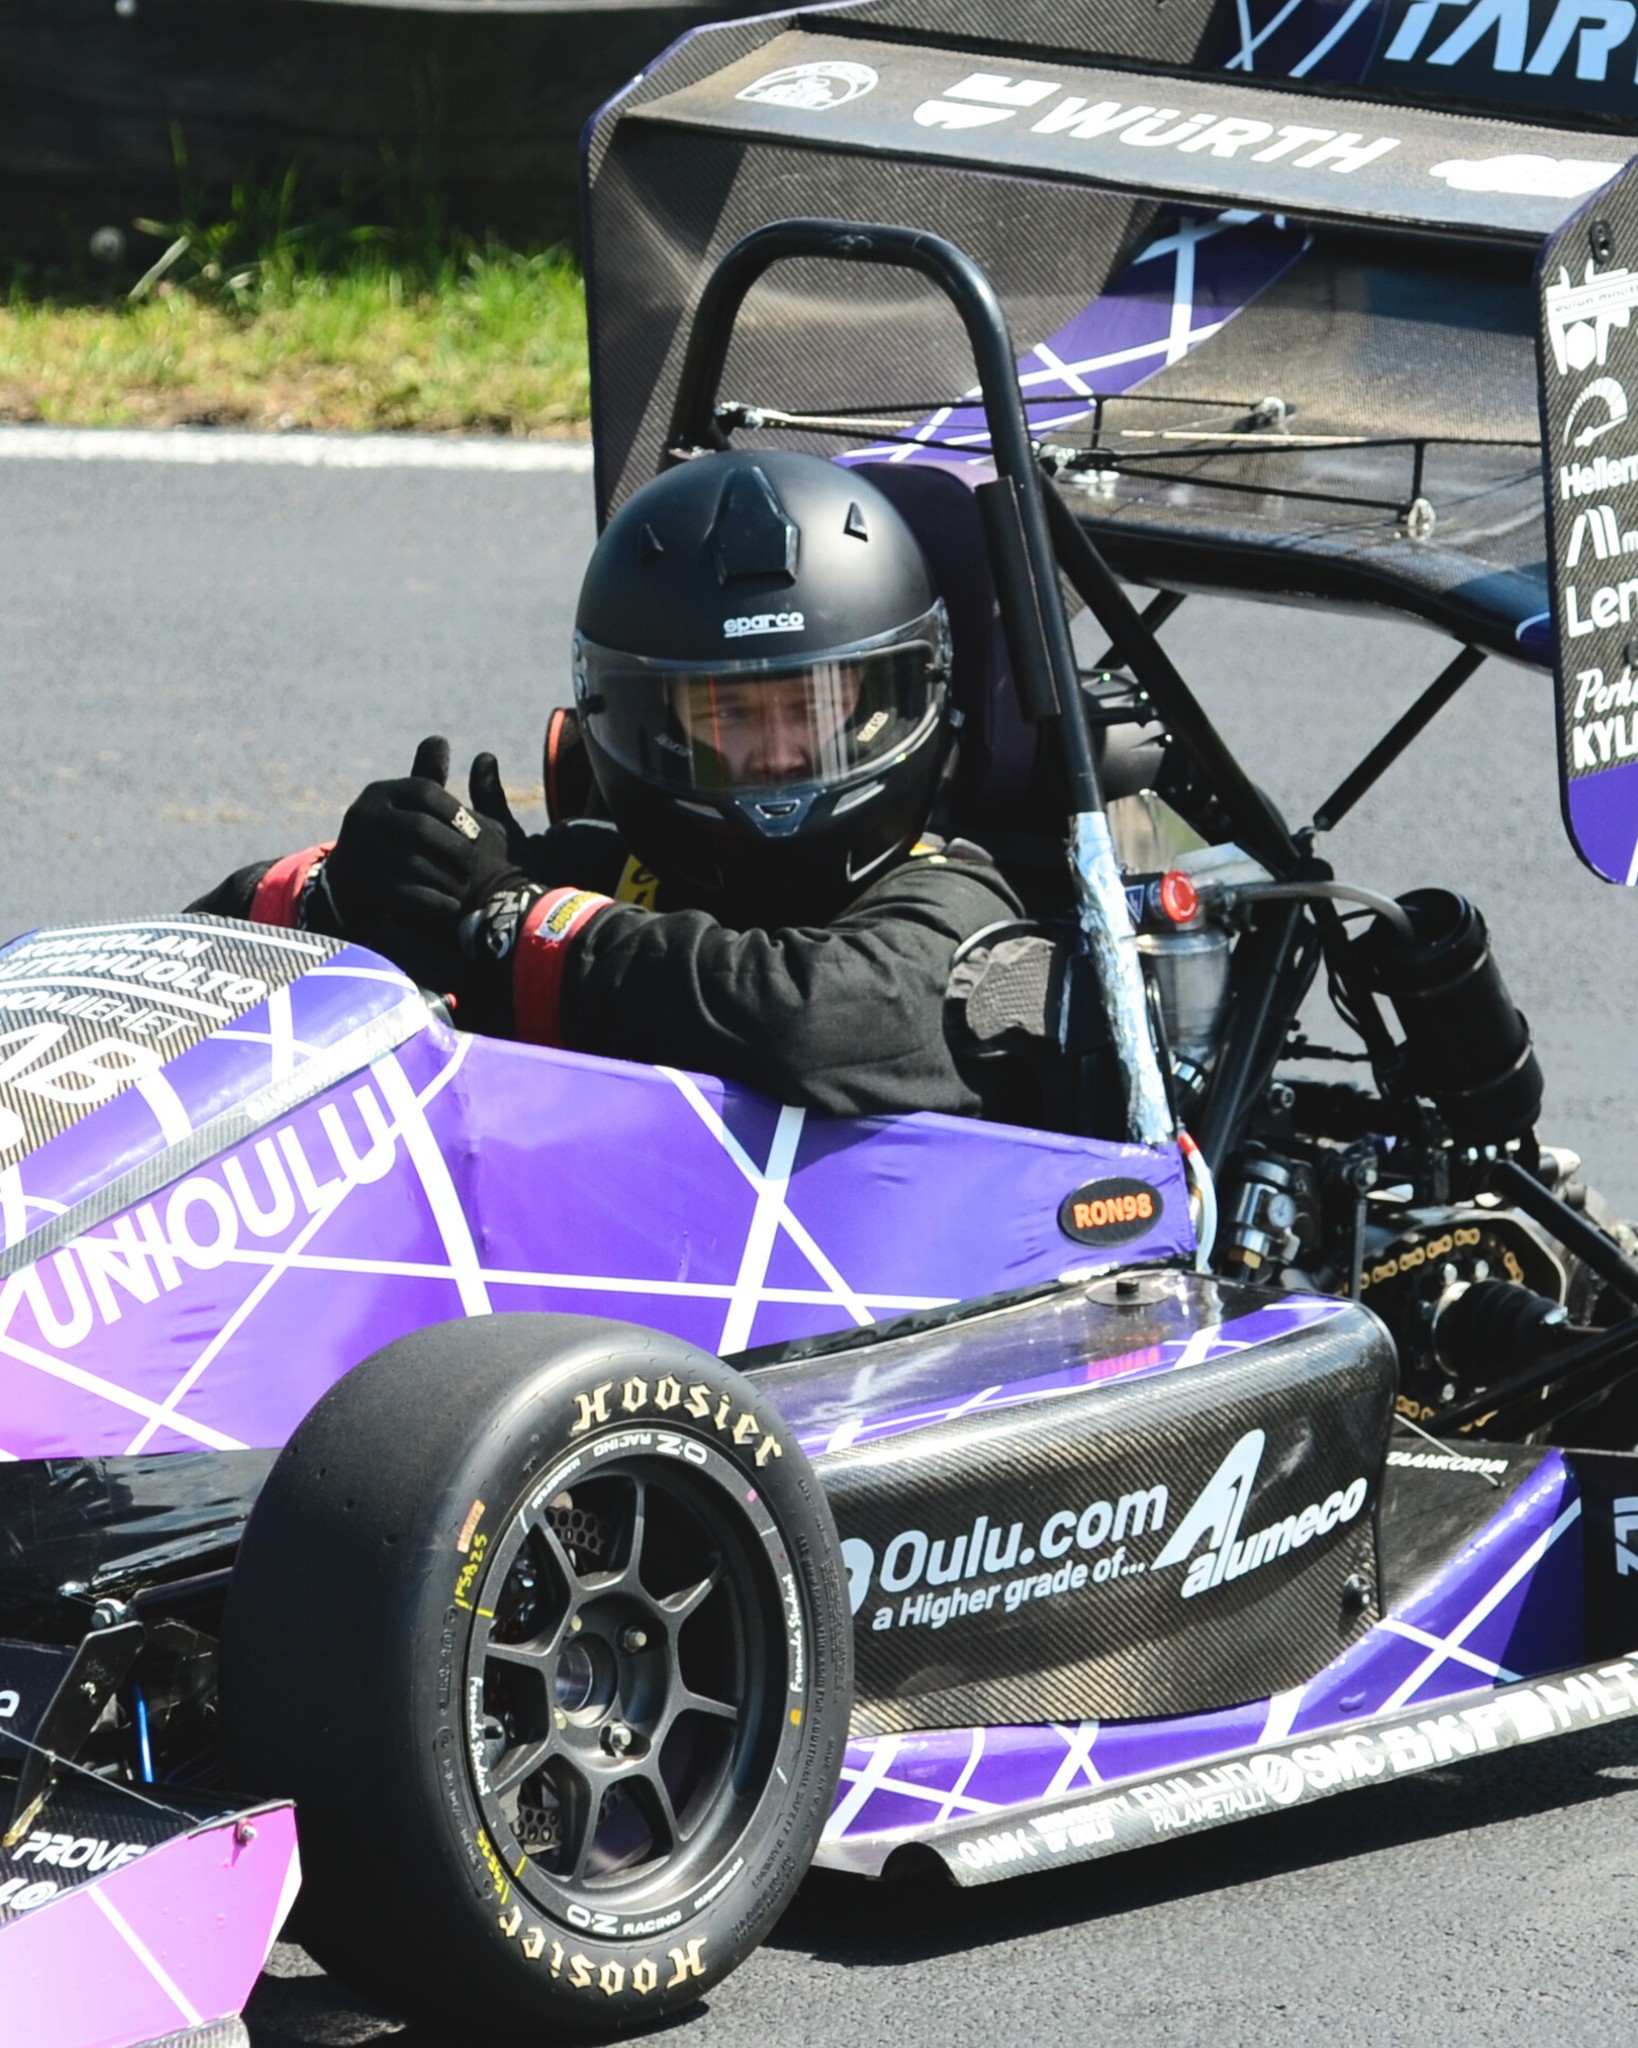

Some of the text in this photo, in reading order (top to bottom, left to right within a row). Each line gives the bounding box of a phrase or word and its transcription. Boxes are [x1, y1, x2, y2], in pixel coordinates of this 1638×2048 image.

[1384, 0, 1638, 84] TAR
[1030, 97, 1401, 174] WÜRTH
[724, 611, 804, 636] sparco
[1573, 710, 1638, 770] KYL
[0, 952, 268, 1004] UTOHUOLTO
[9, 933, 213, 958] KOKKOLAN
[30, 1085, 397, 1348] UNIOULU
[1072, 1192, 1153, 1229] RON98
[570, 1375, 783, 1468] Hoosier
[593, 1432, 652, 1457] RACING
[880, 1485, 1169, 1594] Oulu.com
[1181, 1477, 1368, 1598] alumeco
[872, 1608, 893, 1631] a
[899, 1584, 1000, 1630] Higher
[1003, 1560, 1087, 1612] grade
[1293, 1735, 1386, 1788] SMC
[498, 1903, 711, 1998] Hoosier
[623, 1910, 682, 1935] RACING
